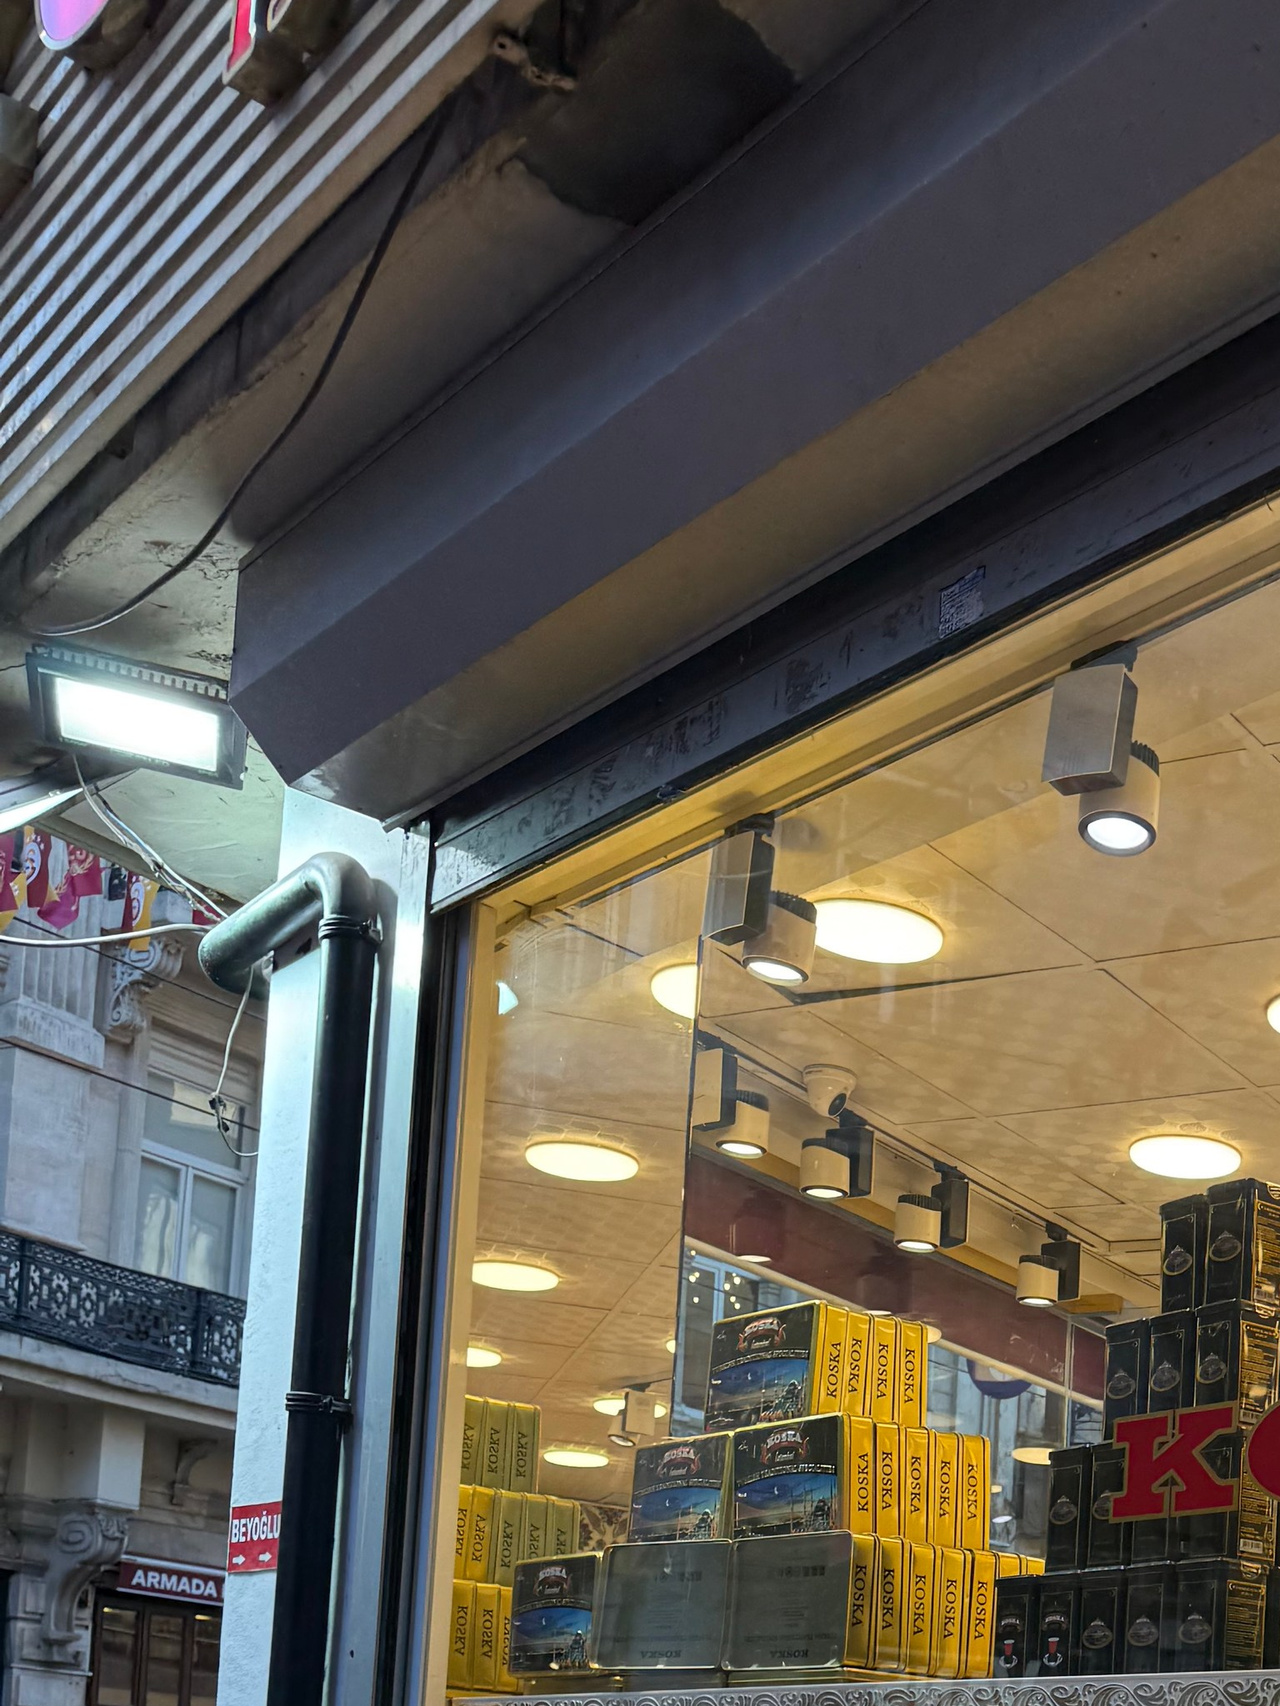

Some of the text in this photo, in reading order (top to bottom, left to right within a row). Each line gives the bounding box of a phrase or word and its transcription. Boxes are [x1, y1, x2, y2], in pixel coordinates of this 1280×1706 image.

[826, 1341, 842, 1398] KOSKA
[848, 1338, 863, 1395] KOSKA
[877, 1342, 889, 1399] KOSKA
[904, 1347, 915, 1404] KOSKA
[857, 1452, 869, 1513] KOSKA
[881, 1451, 893, 1511] KOSKA
[909, 1455, 921, 1514] KOSKA
[938, 1459, 951, 1518] KOSKA
[967, 1463, 978, 1521] KOSKA
[231, 1511, 281, 1543] BEYOĞLU
[131, 1569, 218, 1598] ARMADA
[852, 1564, 867, 1628] KOSKA
[882, 1568, 895, 1631] KOSKA
[913, 1574, 926, 1636] KOSKA
[944, 1579, 957, 1639] KOSKA
[974, 1581, 988, 1640] KOSKA
